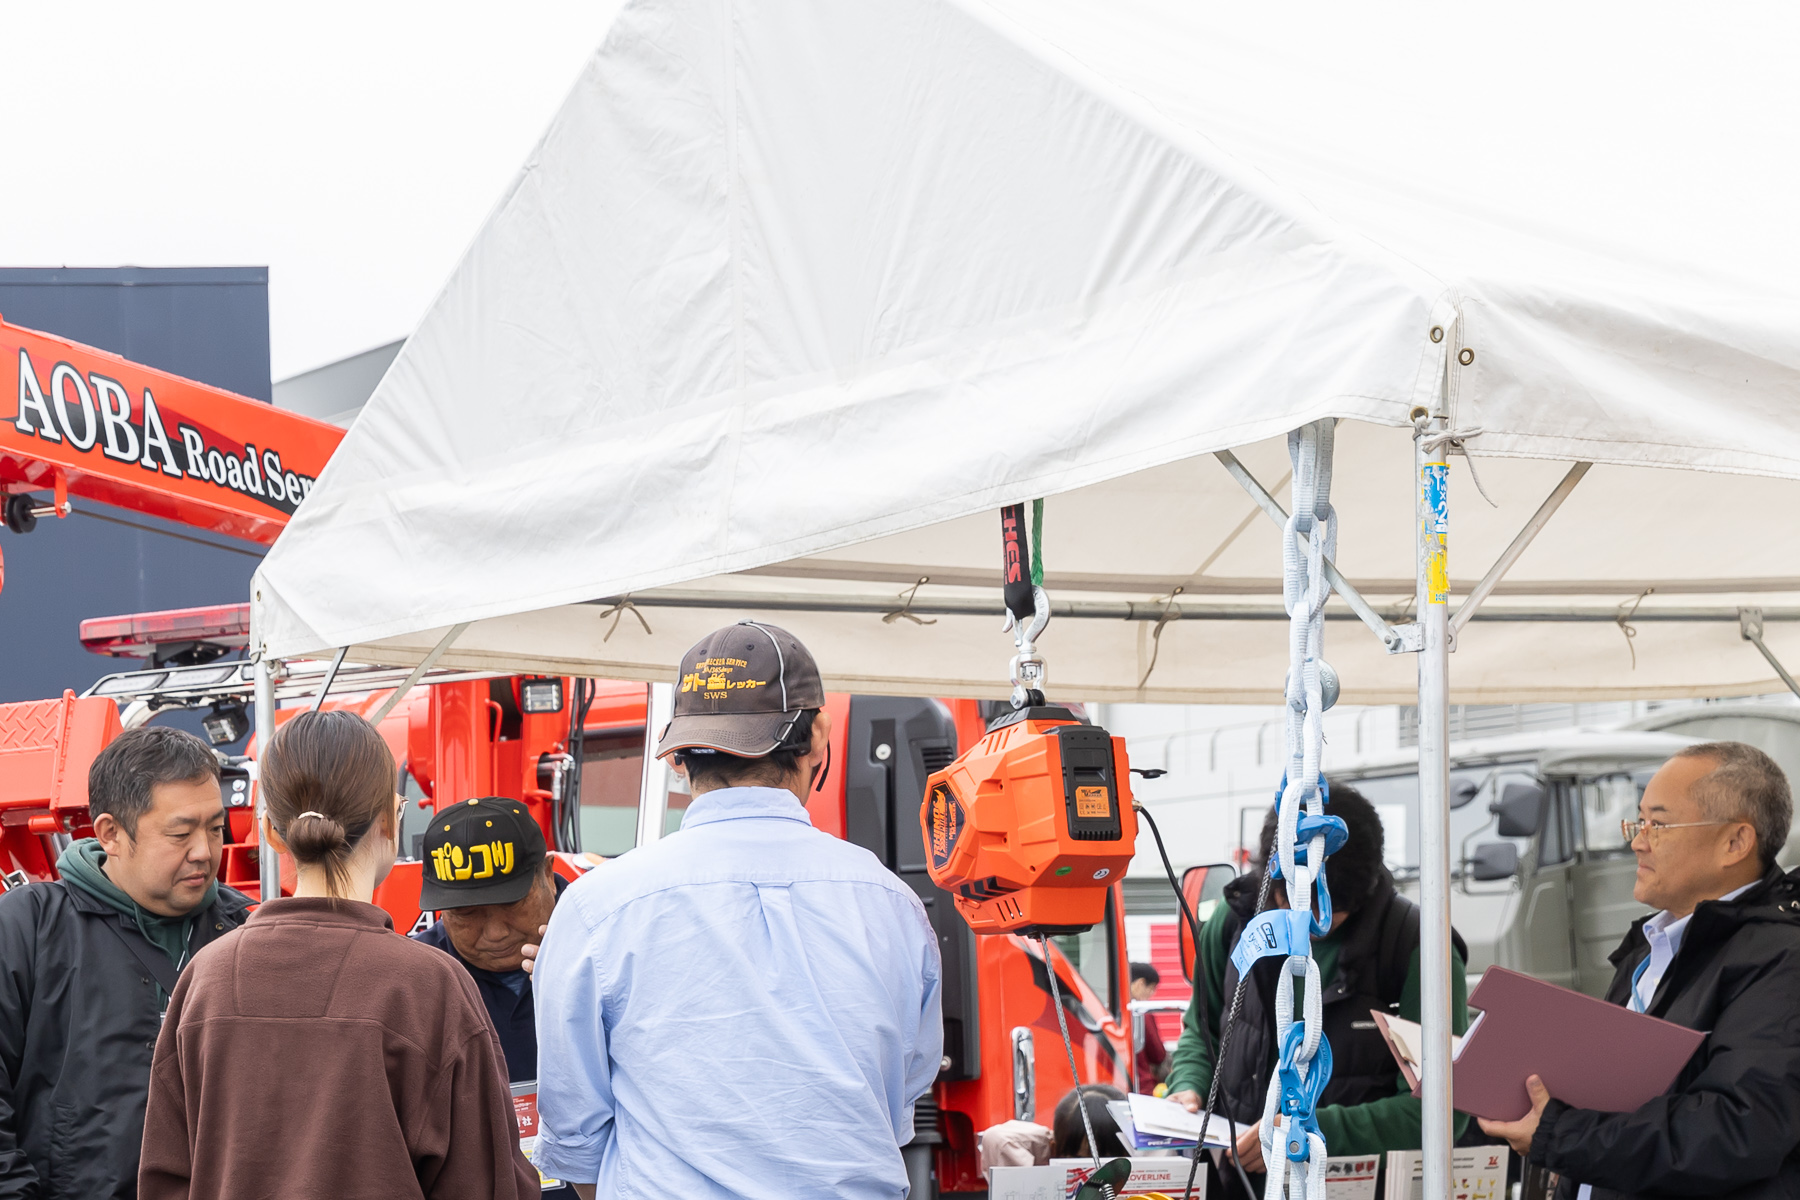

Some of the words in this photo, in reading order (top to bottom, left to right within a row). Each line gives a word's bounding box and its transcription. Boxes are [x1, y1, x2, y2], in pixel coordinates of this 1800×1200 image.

[14, 347, 183, 477] AOBA
[178, 422, 266, 499] Road
[262, 449, 317, 506] Ser
[703, 691, 728, 700] SWS
[431, 840, 515, 881] ポンコツ
